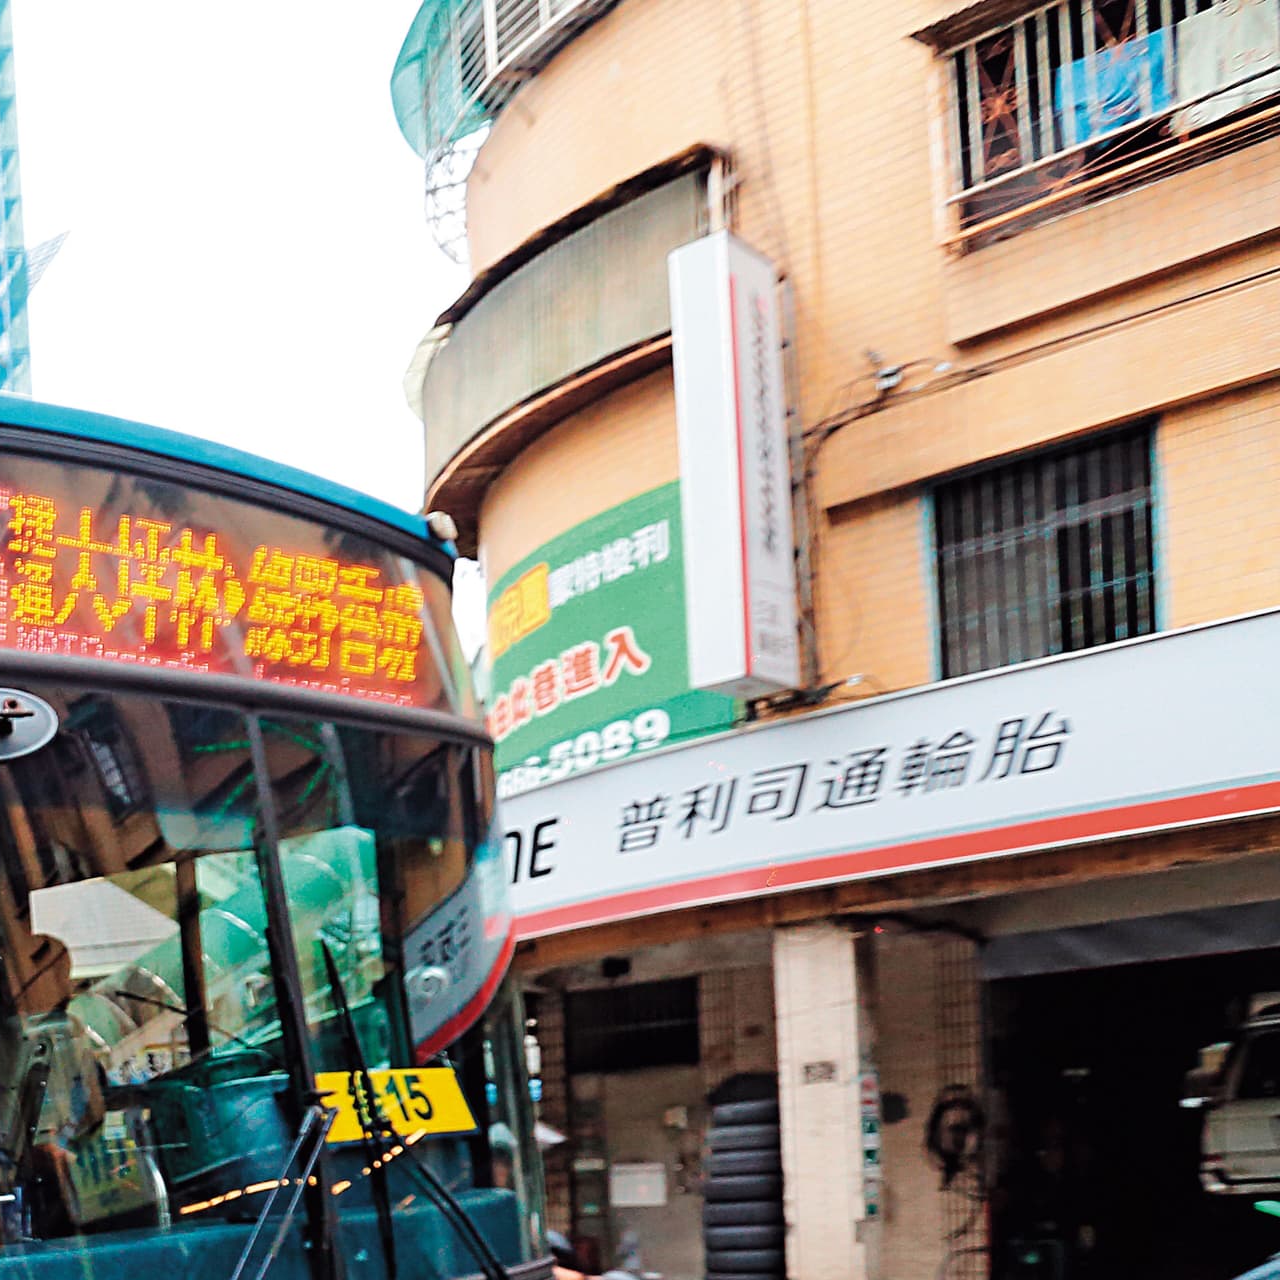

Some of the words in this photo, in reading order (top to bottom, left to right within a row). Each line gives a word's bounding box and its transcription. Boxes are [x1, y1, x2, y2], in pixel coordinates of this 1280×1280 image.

[618, 712, 1072, 855] 普利司通輪胎
